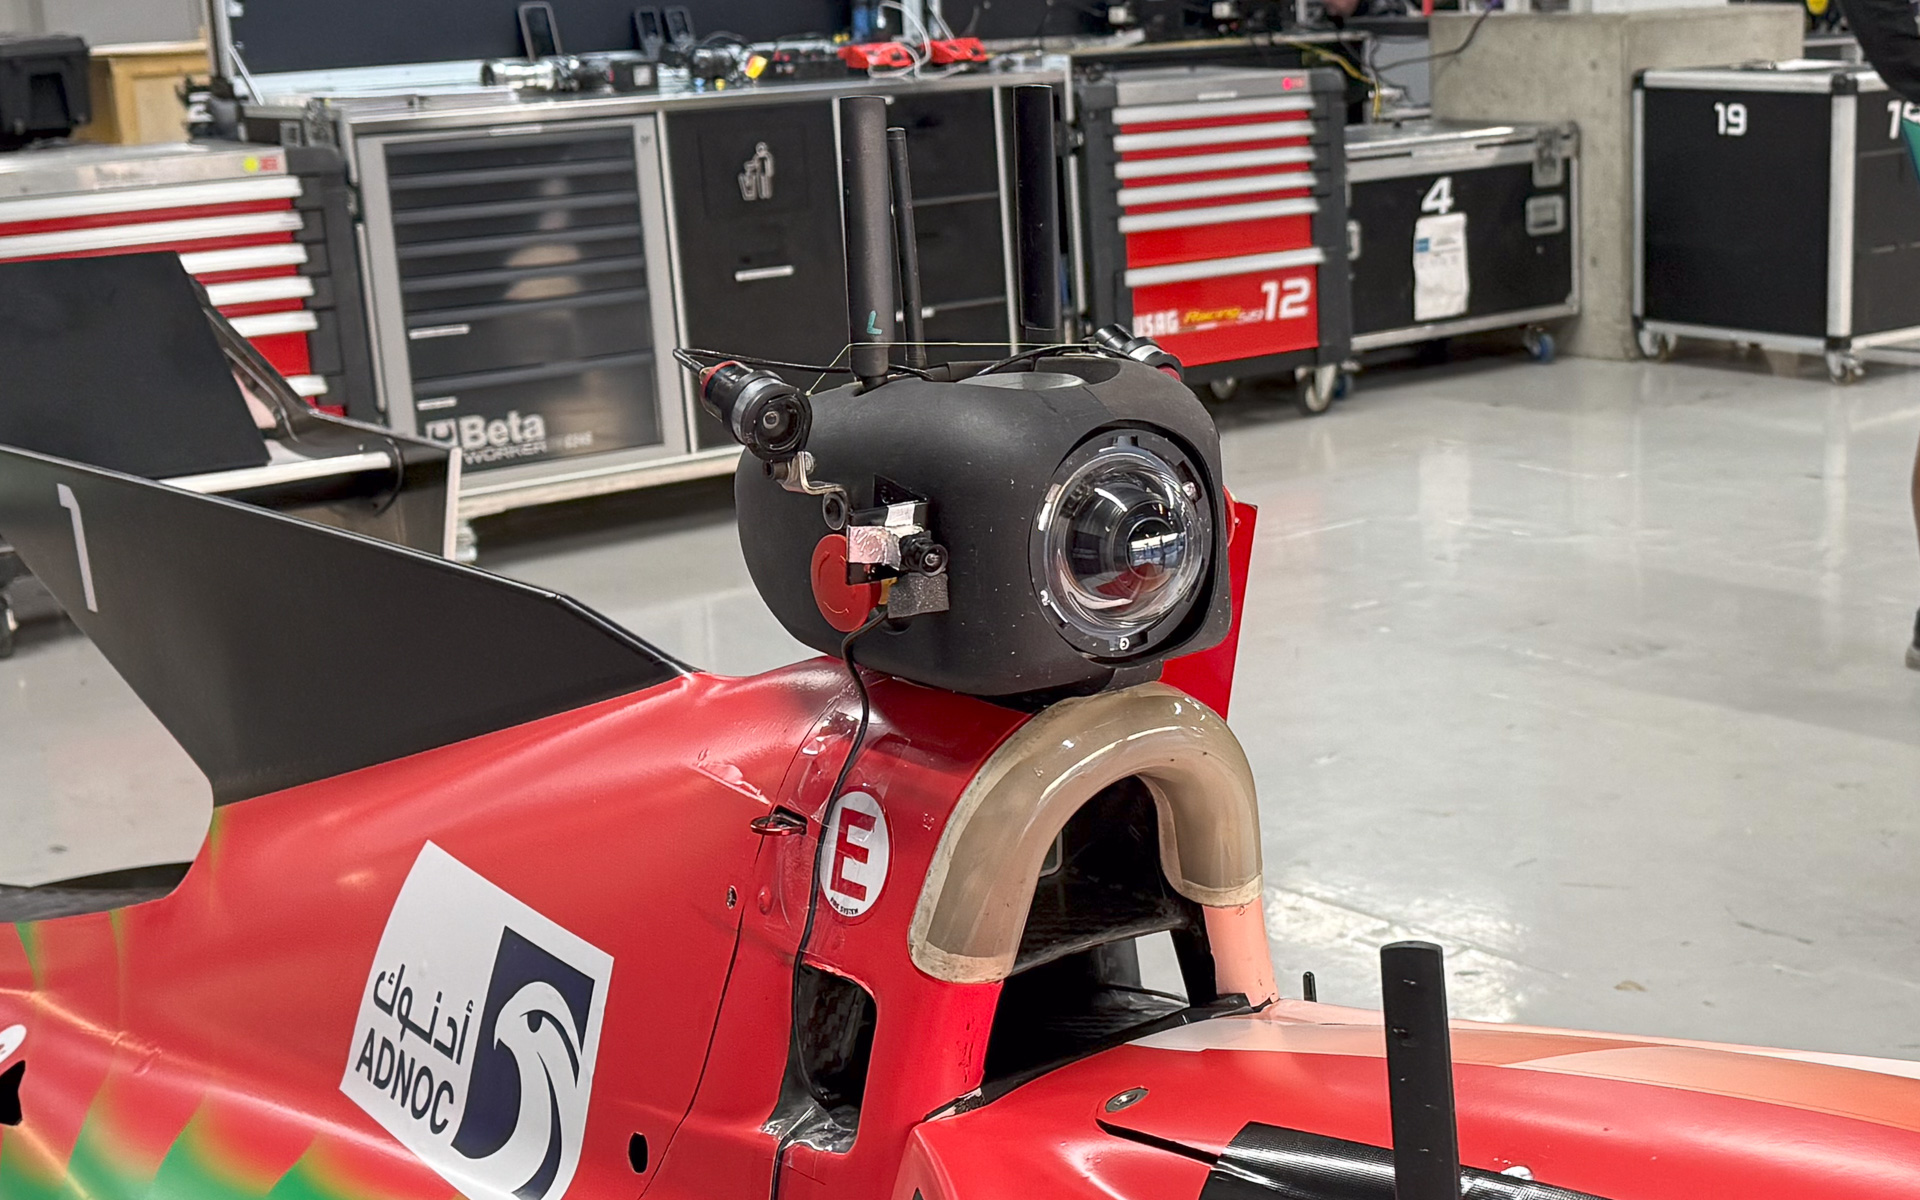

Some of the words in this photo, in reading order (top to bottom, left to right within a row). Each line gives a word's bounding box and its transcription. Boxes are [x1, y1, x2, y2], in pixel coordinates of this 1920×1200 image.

[1714, 102, 1747, 136] 19
[1420, 176, 1454, 215] 4
[1260, 277, 1311, 321] 12
[867, 310, 883, 335] L
[459, 409, 546, 450] Beta
[56, 483, 99, 613] 1
[829, 806, 877, 902] E
[373, 963, 474, 1066] أدنوك
[354, 1027, 455, 1135] ADNOC
